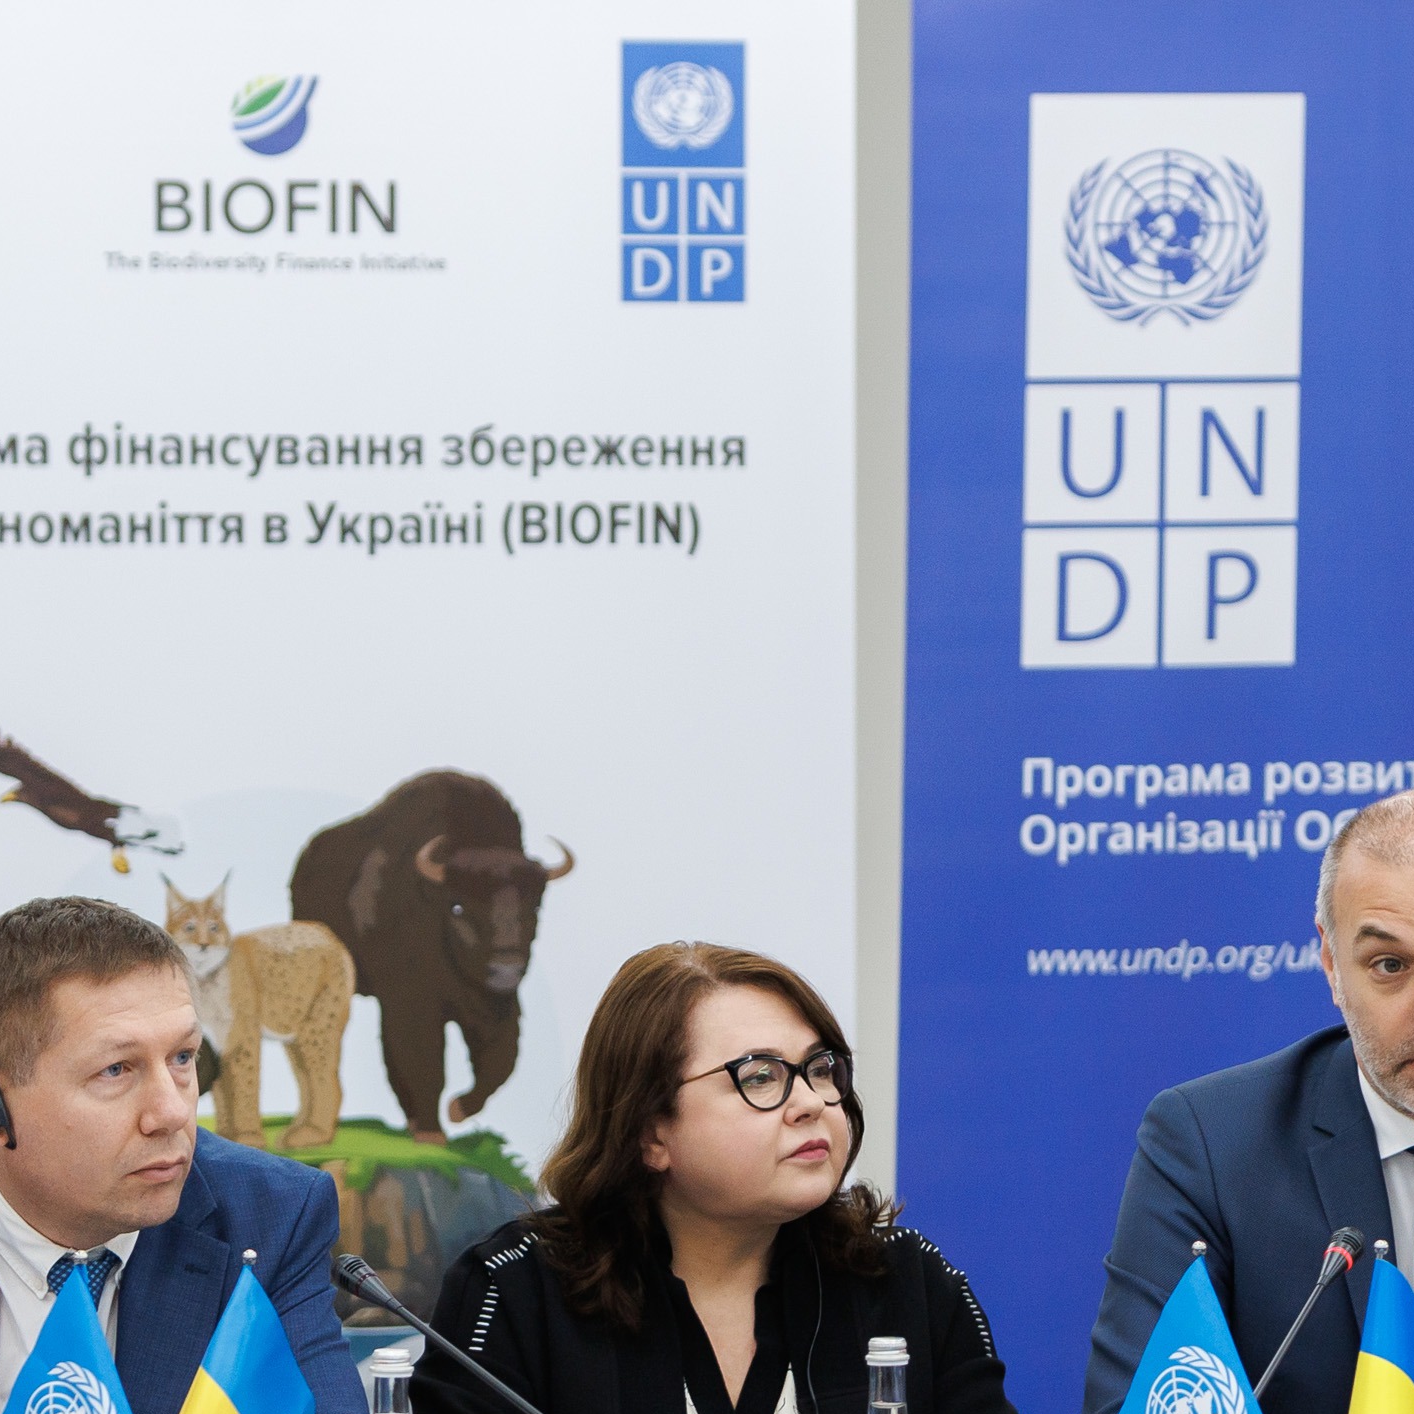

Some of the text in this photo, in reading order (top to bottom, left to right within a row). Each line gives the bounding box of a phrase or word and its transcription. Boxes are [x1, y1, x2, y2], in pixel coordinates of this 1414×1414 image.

[154, 179, 398, 236] BIOFIN
[629, 181, 735, 231] UN
[104, 250, 449, 275] The Biodiversity Finance Initiative
[630, 246, 733, 297] DP
[68, 424, 425, 480] фінансування
[442, 425, 747, 477] збереження
[1057, 404, 1267, 501] UN
[264, 514, 290, 546] в
[307, 503, 484, 557] Україні
[502, 502, 702, 557] (BIOFIN)
[1054, 549, 1261, 643] DP
[1022, 757, 1252, 808] Програма
[1020, 811, 1285, 867] Організації
[1027, 938, 1323, 982] www.undp.org/uk
